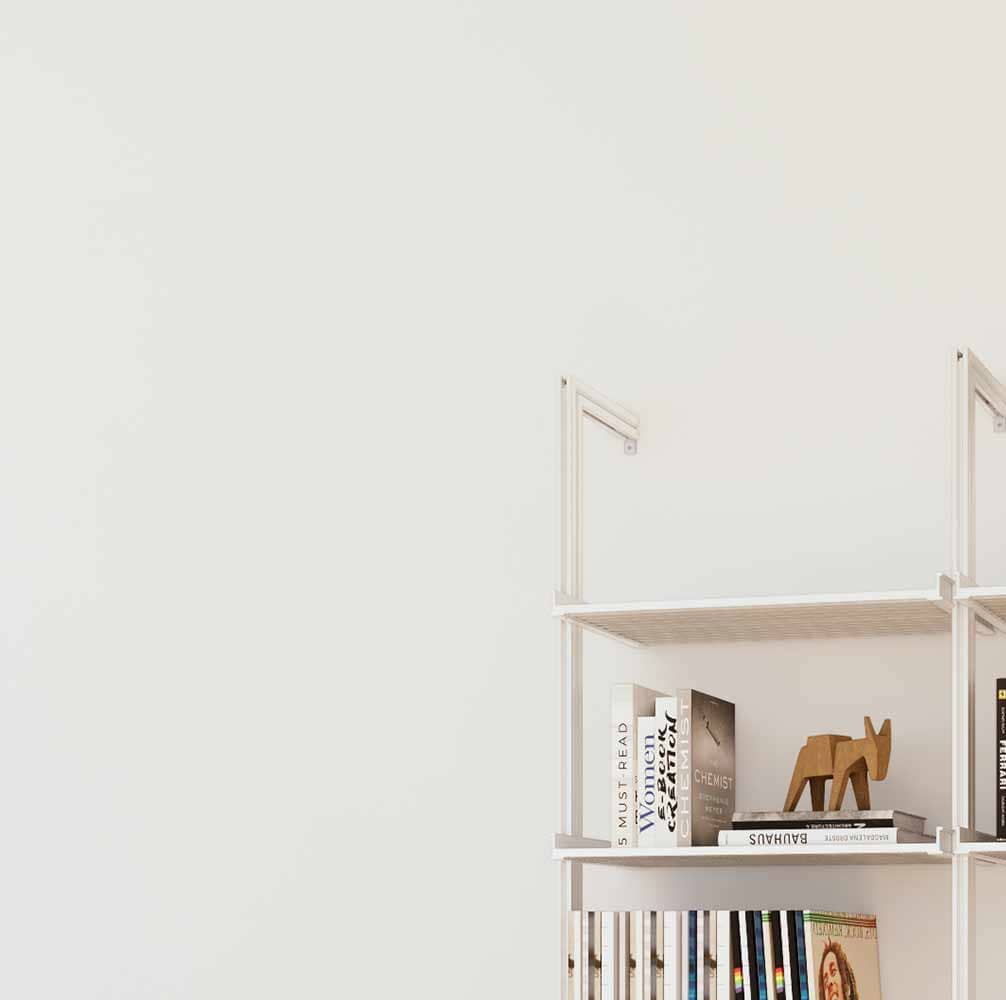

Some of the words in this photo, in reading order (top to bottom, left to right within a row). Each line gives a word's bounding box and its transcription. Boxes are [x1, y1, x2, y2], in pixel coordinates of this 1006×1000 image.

[639, 734, 656, 833] Women
[658, 724, 667, 820] E-BOOK
[665, 710, 678, 833] CREATION
[680, 697, 690, 839] CHEMIST
[694, 769, 734, 791] CHEMIST
[618, 837, 628, 846] 5
[748, 833, 808, 846] BAUHAUS
